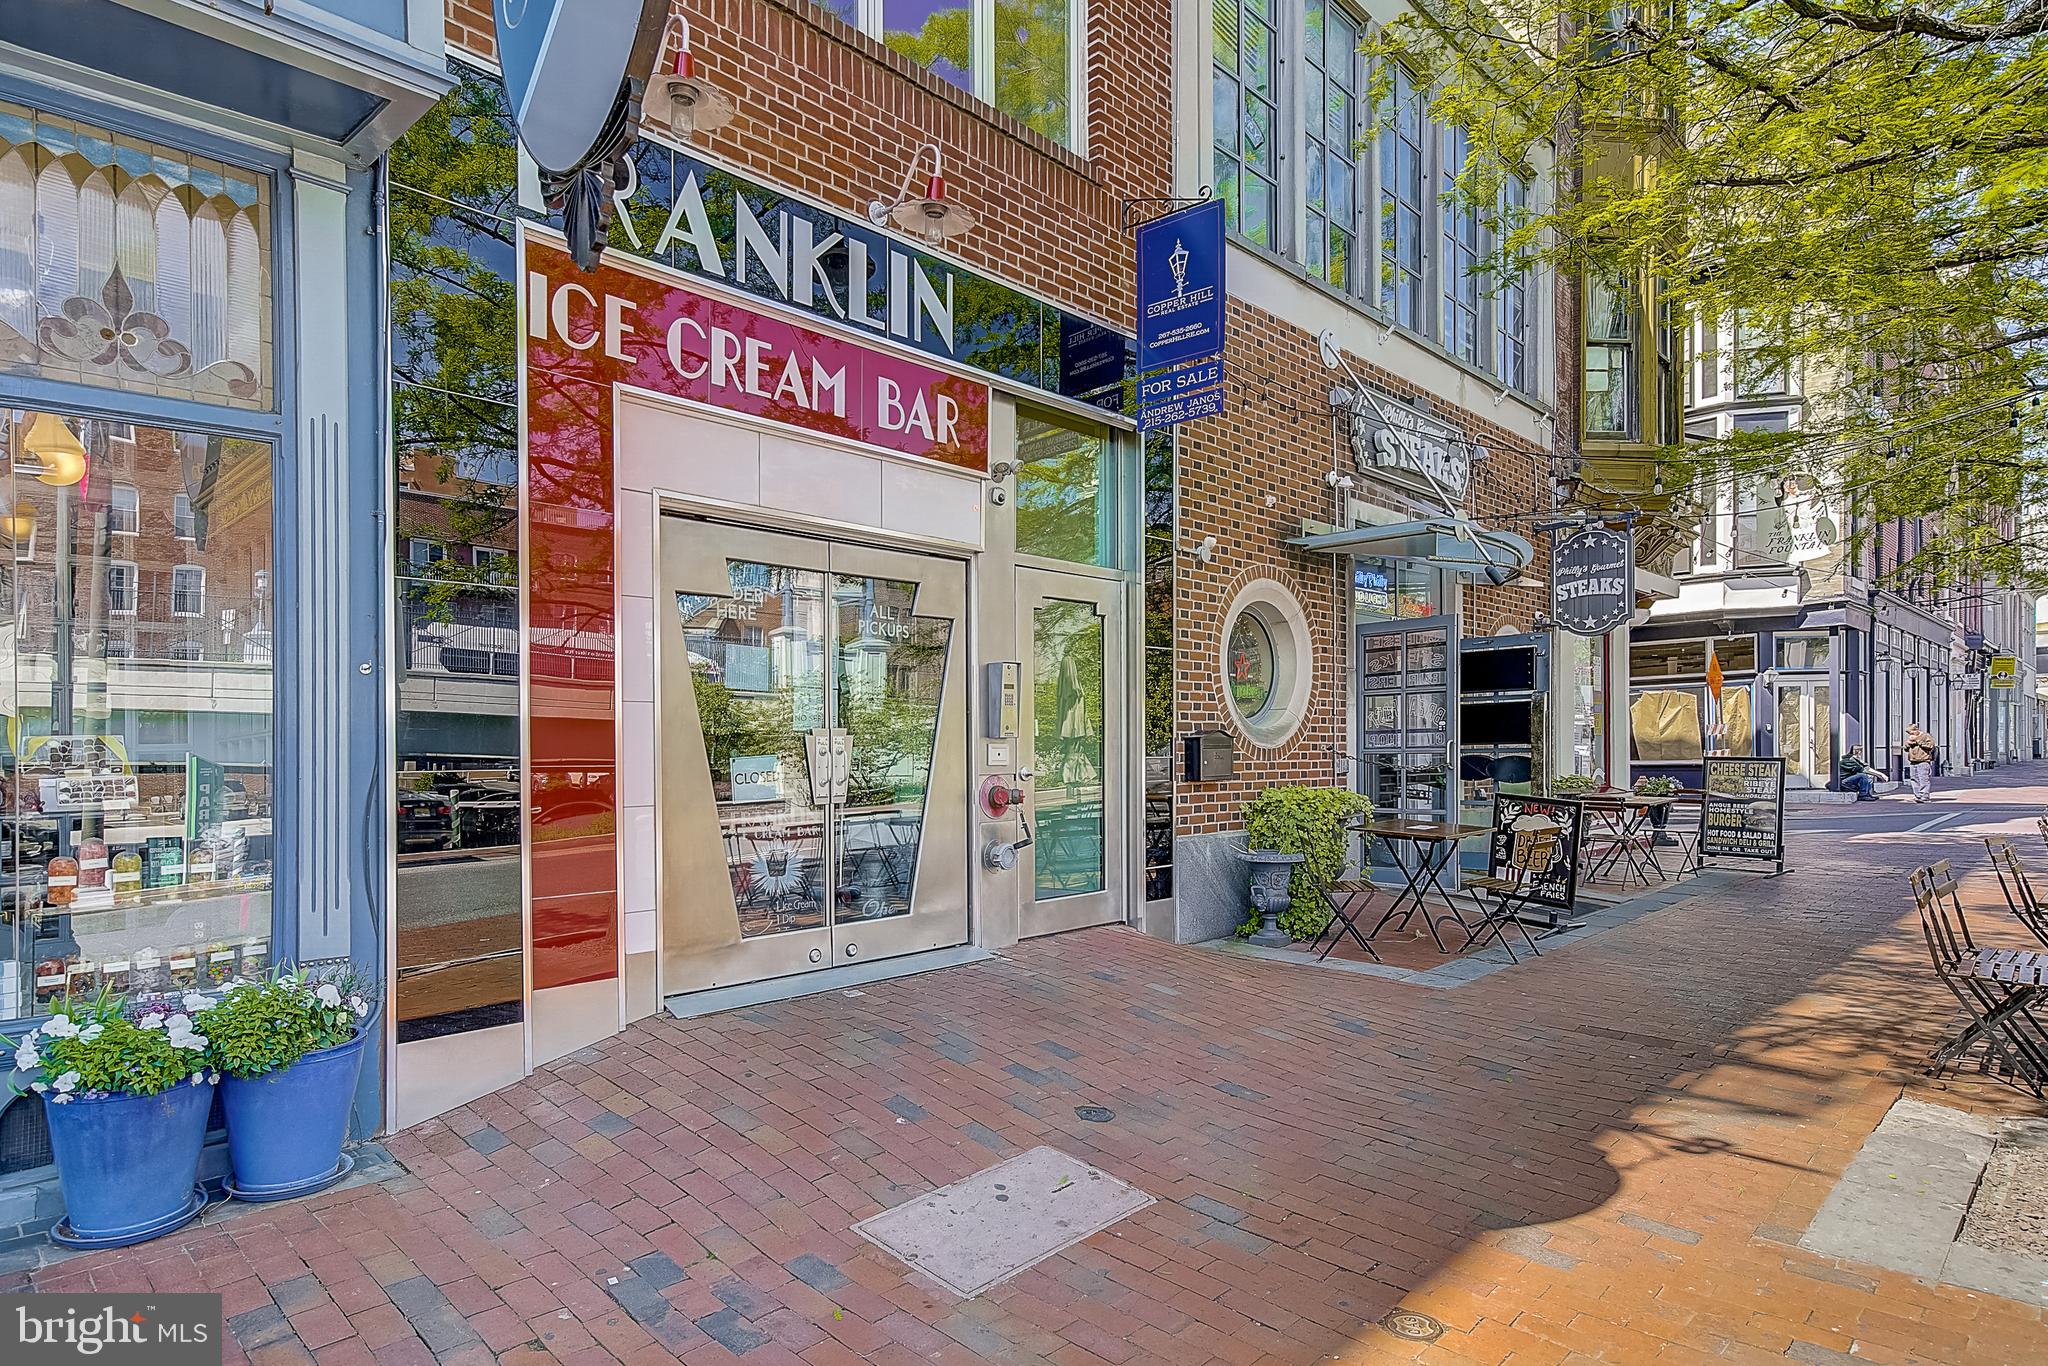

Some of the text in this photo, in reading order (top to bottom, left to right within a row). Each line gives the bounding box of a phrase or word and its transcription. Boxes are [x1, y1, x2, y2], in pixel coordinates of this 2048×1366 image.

[1147, 289, 1214, 315] COPPER HILL
[1160, 300, 1199, 316] REAL ESTATE
[529, 270, 961, 449] ICE CREAM BAR
[1142, 366, 1219, 397] FOR SALE
[1140, 392, 1221, 420] ANDREW JANOS
[1143, 402, 1216, 430] 215-262-5739
[1765, 529, 1832, 548] FRANKLIN
[1768, 539, 1832, 555] FOUNTAIN
[1556, 559, 1625, 577] Philly's Gourmet
[1556, 577, 1625, 602] STEAKS
[716, 602, 757, 621] HERE
[870, 603, 895, 620] ALL
[859, 619, 909, 639] PICKUPS
[735, 771, 780, 785] CLOSED
[1710, 762, 1778, 777] CHEESE STEAK
[1523, 803, 1556, 815] NEW!
[1708, 813, 1742, 827] BURGER
[1706, 836, 1737, 845] SANDWICH
[1758, 839, 1775, 847] GRILL
[1707, 829, 1719, 837] HOT
[1720, 830, 1736, 838] FOOD
[1742, 831, 1762, 839] SALAD
[1763, 832, 1775, 840] BAR
[1540, 890, 1566, 901] FRIES
